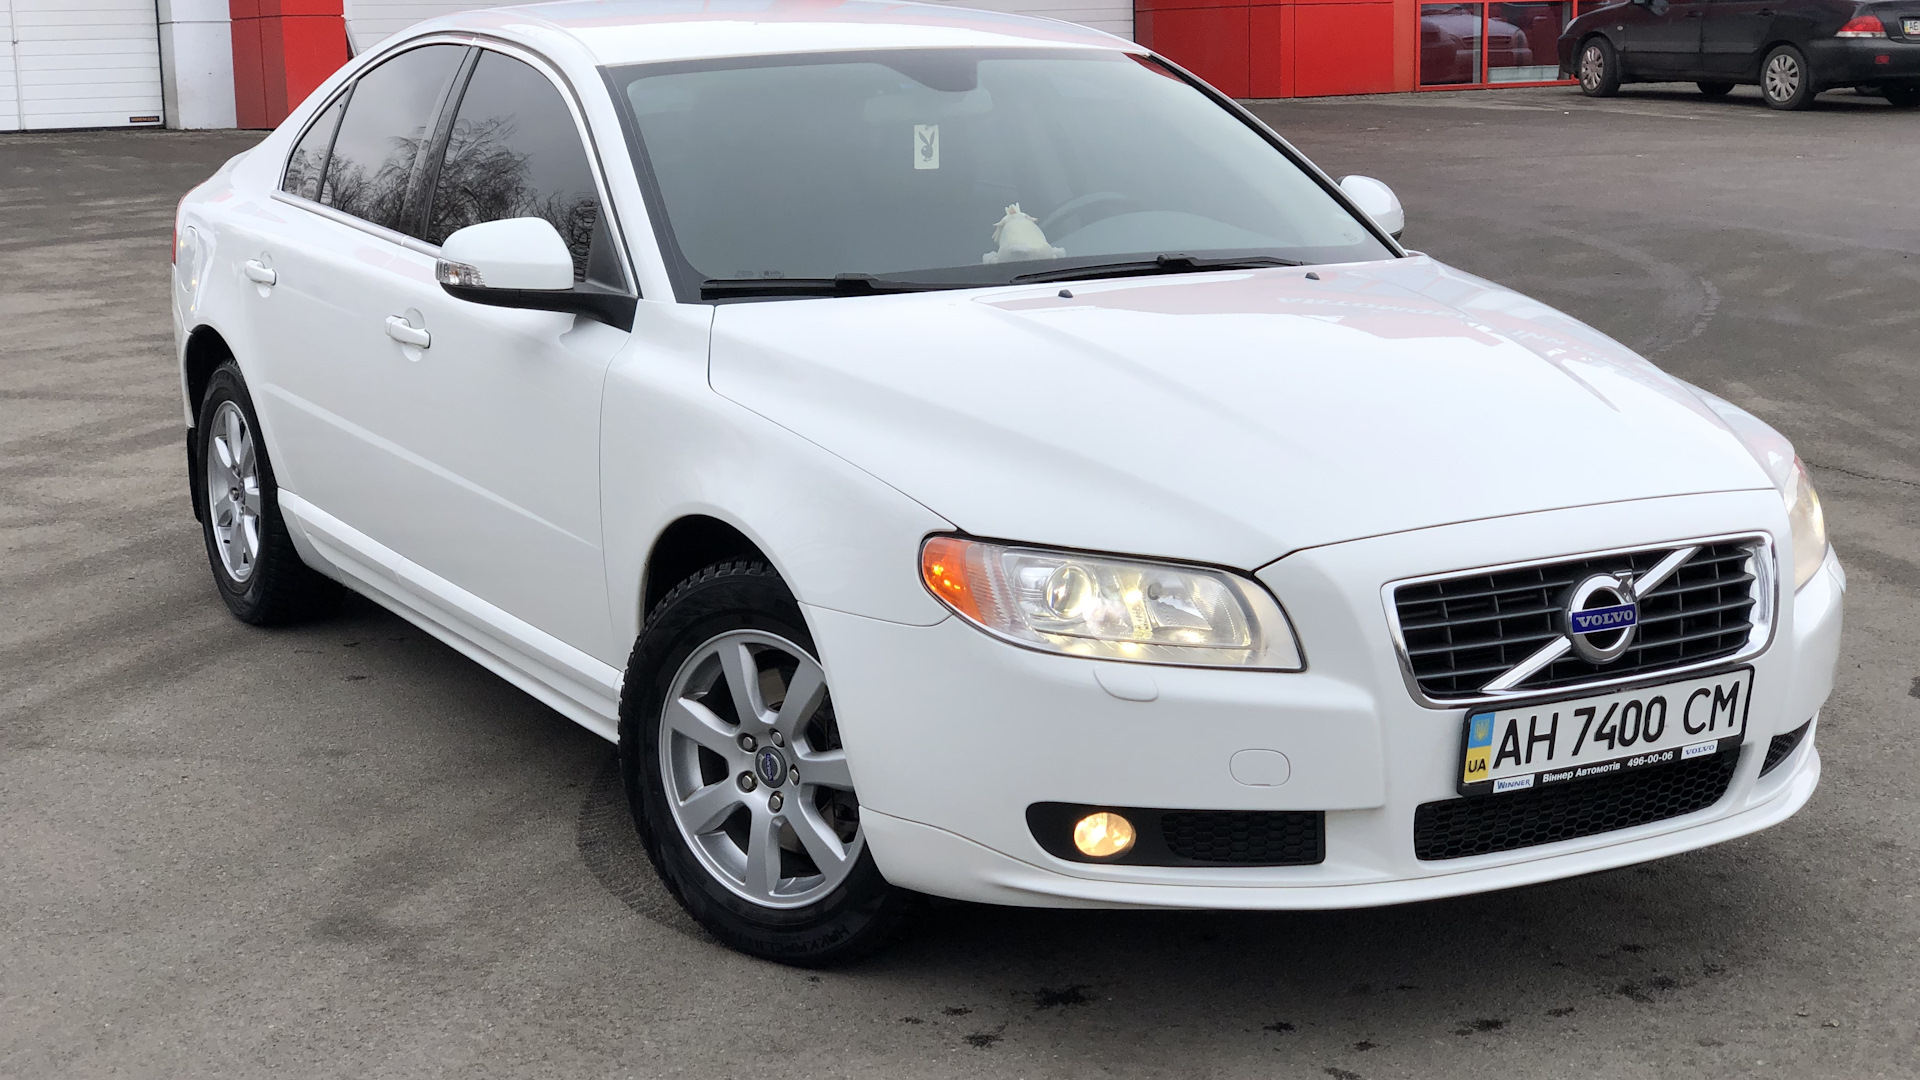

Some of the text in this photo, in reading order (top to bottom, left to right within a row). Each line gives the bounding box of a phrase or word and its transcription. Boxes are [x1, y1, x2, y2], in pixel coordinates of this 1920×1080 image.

[1576, 609, 1633, 628] VOLVO
[1493, 681, 1740, 769] AH 7400 CM
[1685, 744, 1715, 756] VOLVO
[1468, 758, 1487, 773] UA
[1542, 751, 1674, 783] Віннер Автомотів 496-00-06
